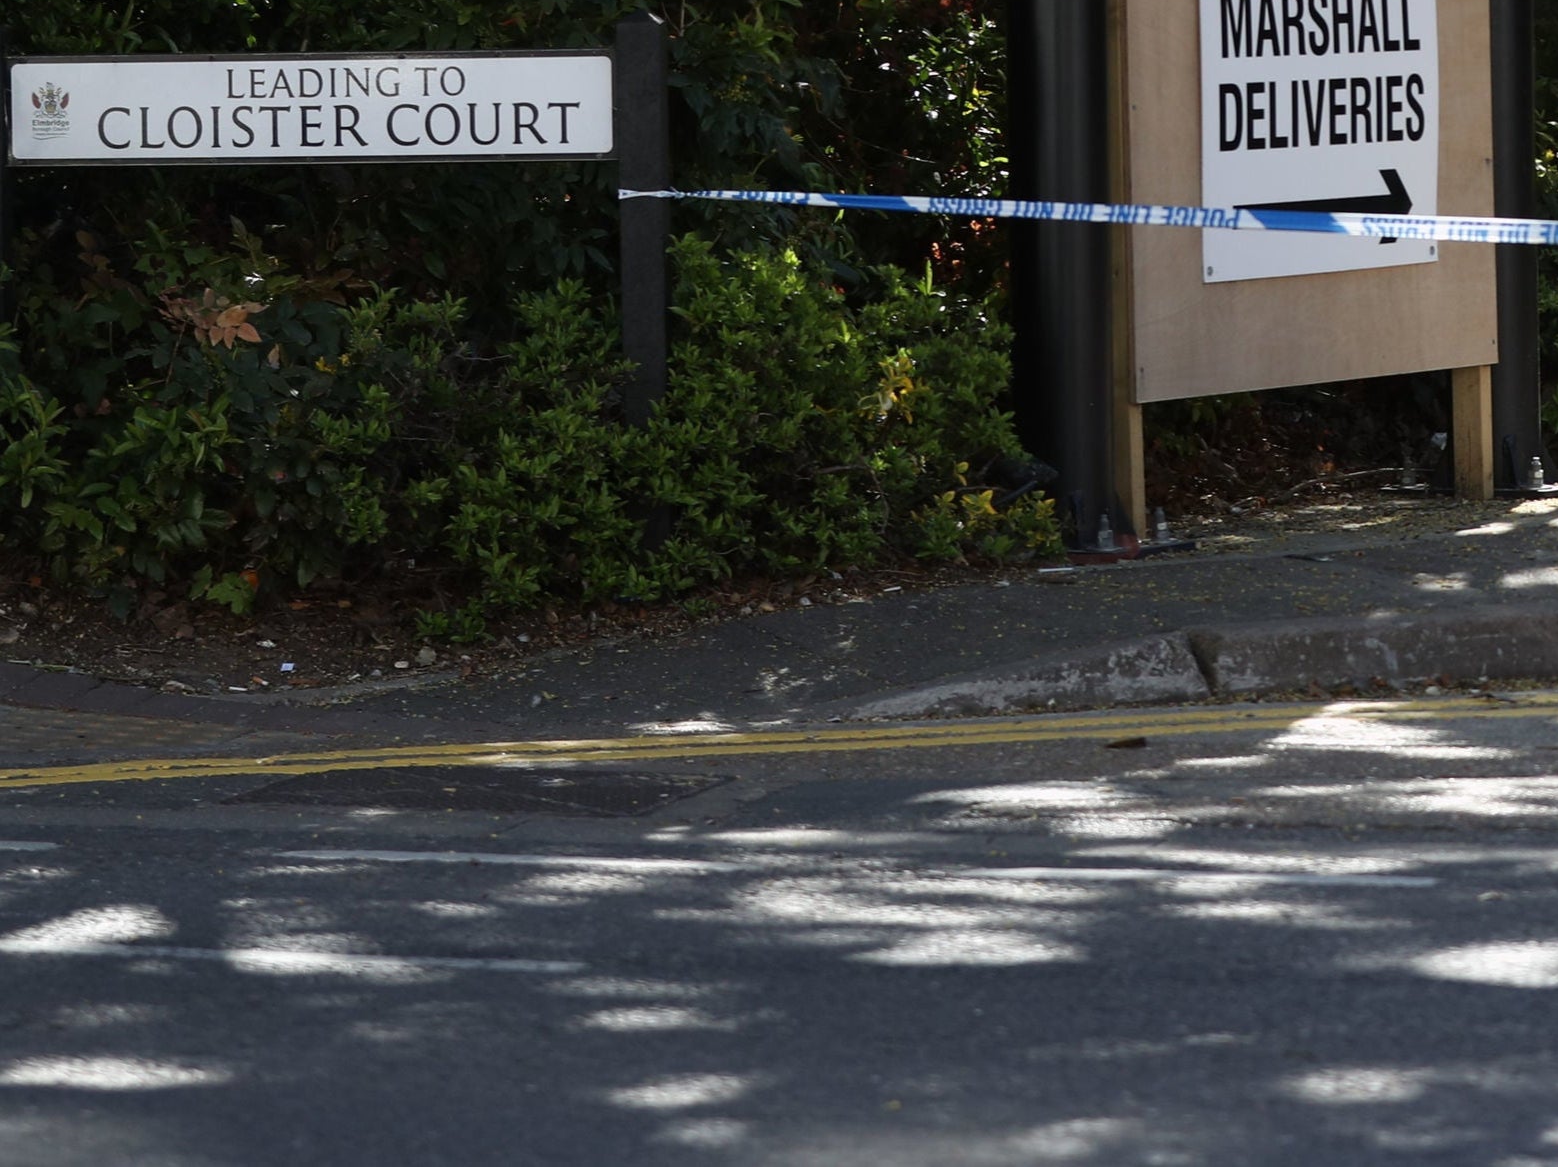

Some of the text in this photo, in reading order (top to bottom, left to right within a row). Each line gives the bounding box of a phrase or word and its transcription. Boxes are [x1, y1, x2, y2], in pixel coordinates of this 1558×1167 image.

[226, 65, 467, 99] LEADING TO
[97, 101, 581, 150] CLOISTER COURT
[1218, 73, 1426, 152] DELIVERIES
[1103, 204, 1153, 224] LINE
[1161, 206, 1240, 229] POLICE
